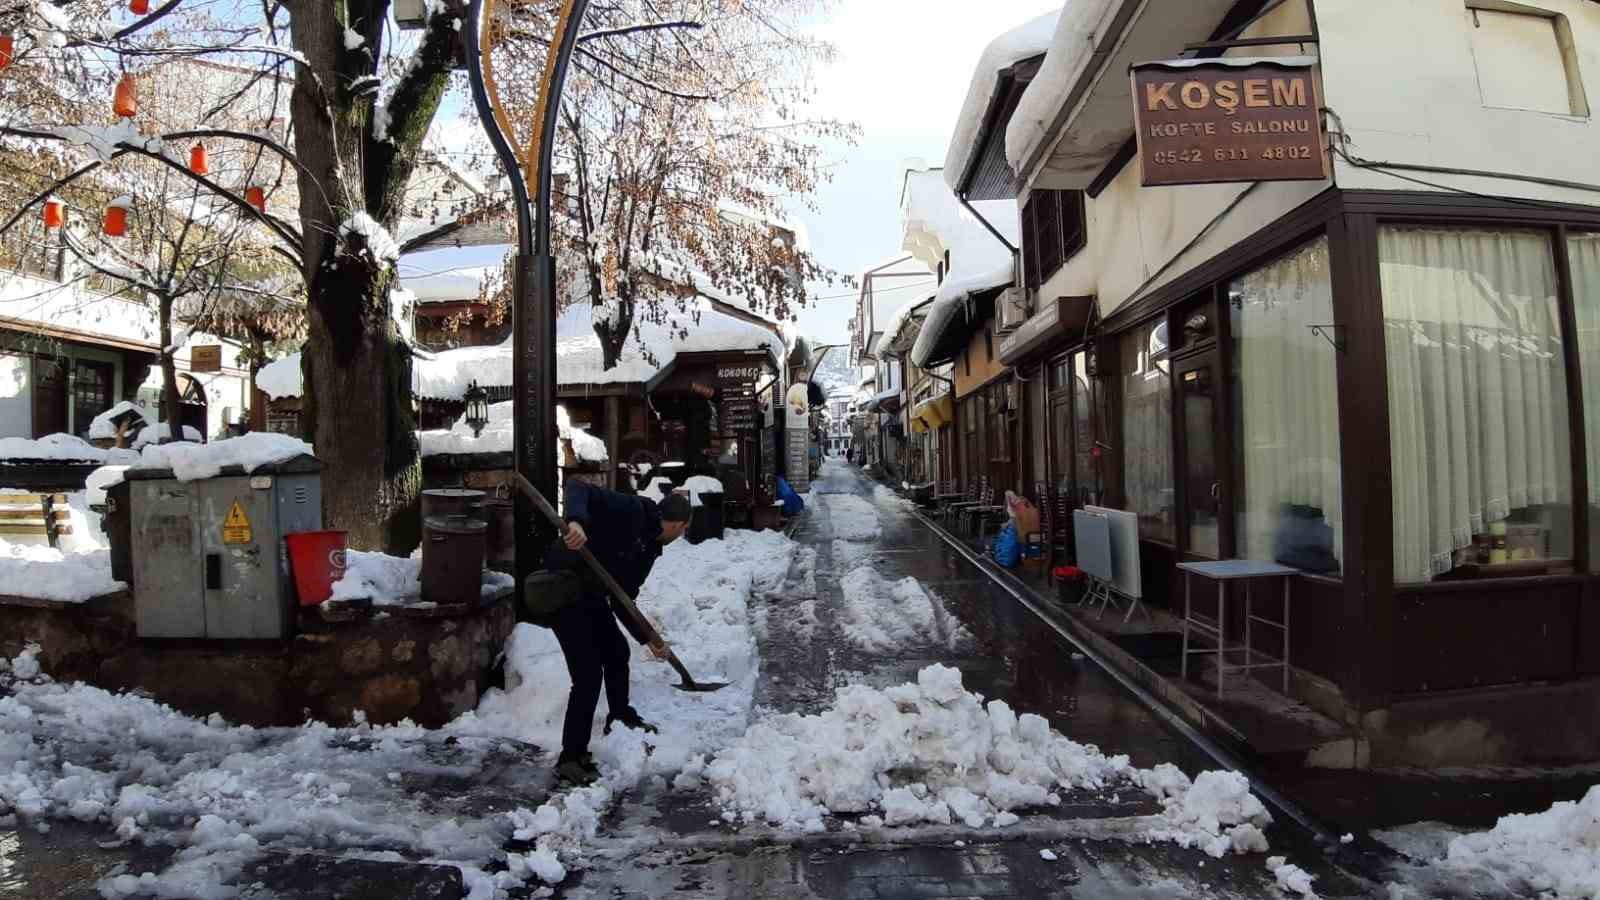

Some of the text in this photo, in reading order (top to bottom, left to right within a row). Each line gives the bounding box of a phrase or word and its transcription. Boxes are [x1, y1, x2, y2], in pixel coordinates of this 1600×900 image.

[1231, 119, 1309, 134] SALONU
[1154, 146, 1312, 165] 0542 611 4802
